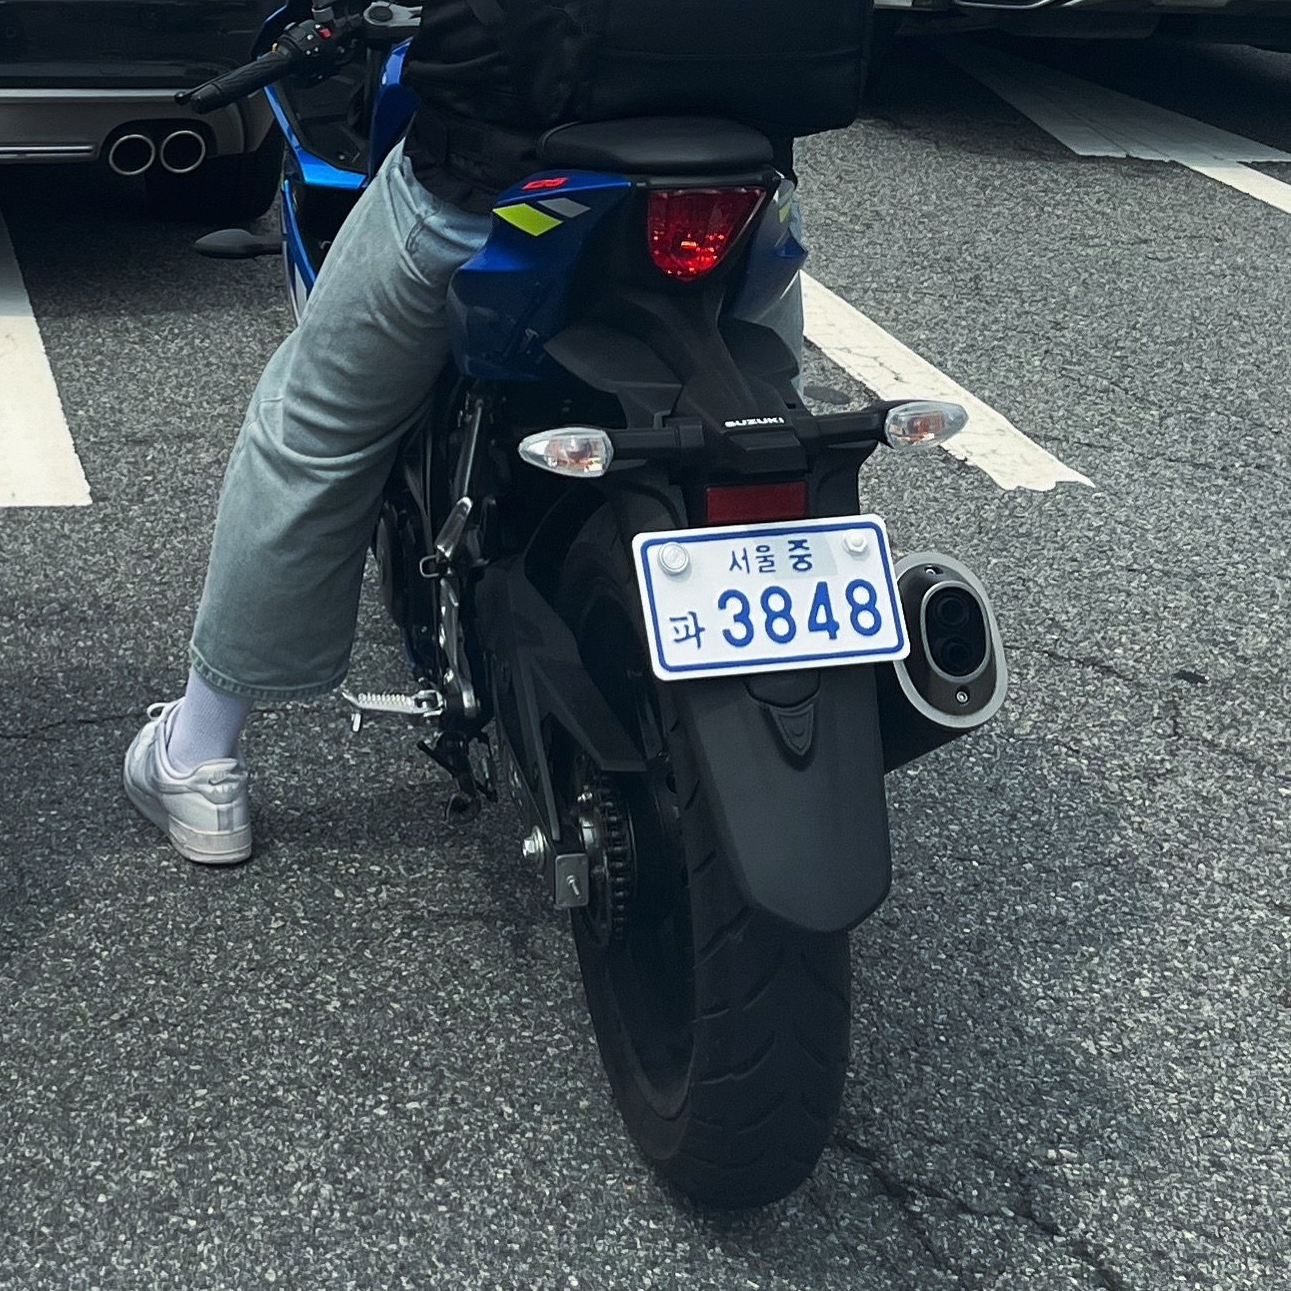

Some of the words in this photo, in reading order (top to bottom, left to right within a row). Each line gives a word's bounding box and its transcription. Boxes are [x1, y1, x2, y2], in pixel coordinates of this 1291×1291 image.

[724, 416, 785, 428] SUZUKI
[728, 544, 777, 574] 서울
[787, 538, 814, 573] 중
[669, 611, 706, 650] 파
[717, 578, 883, 648] 3848
